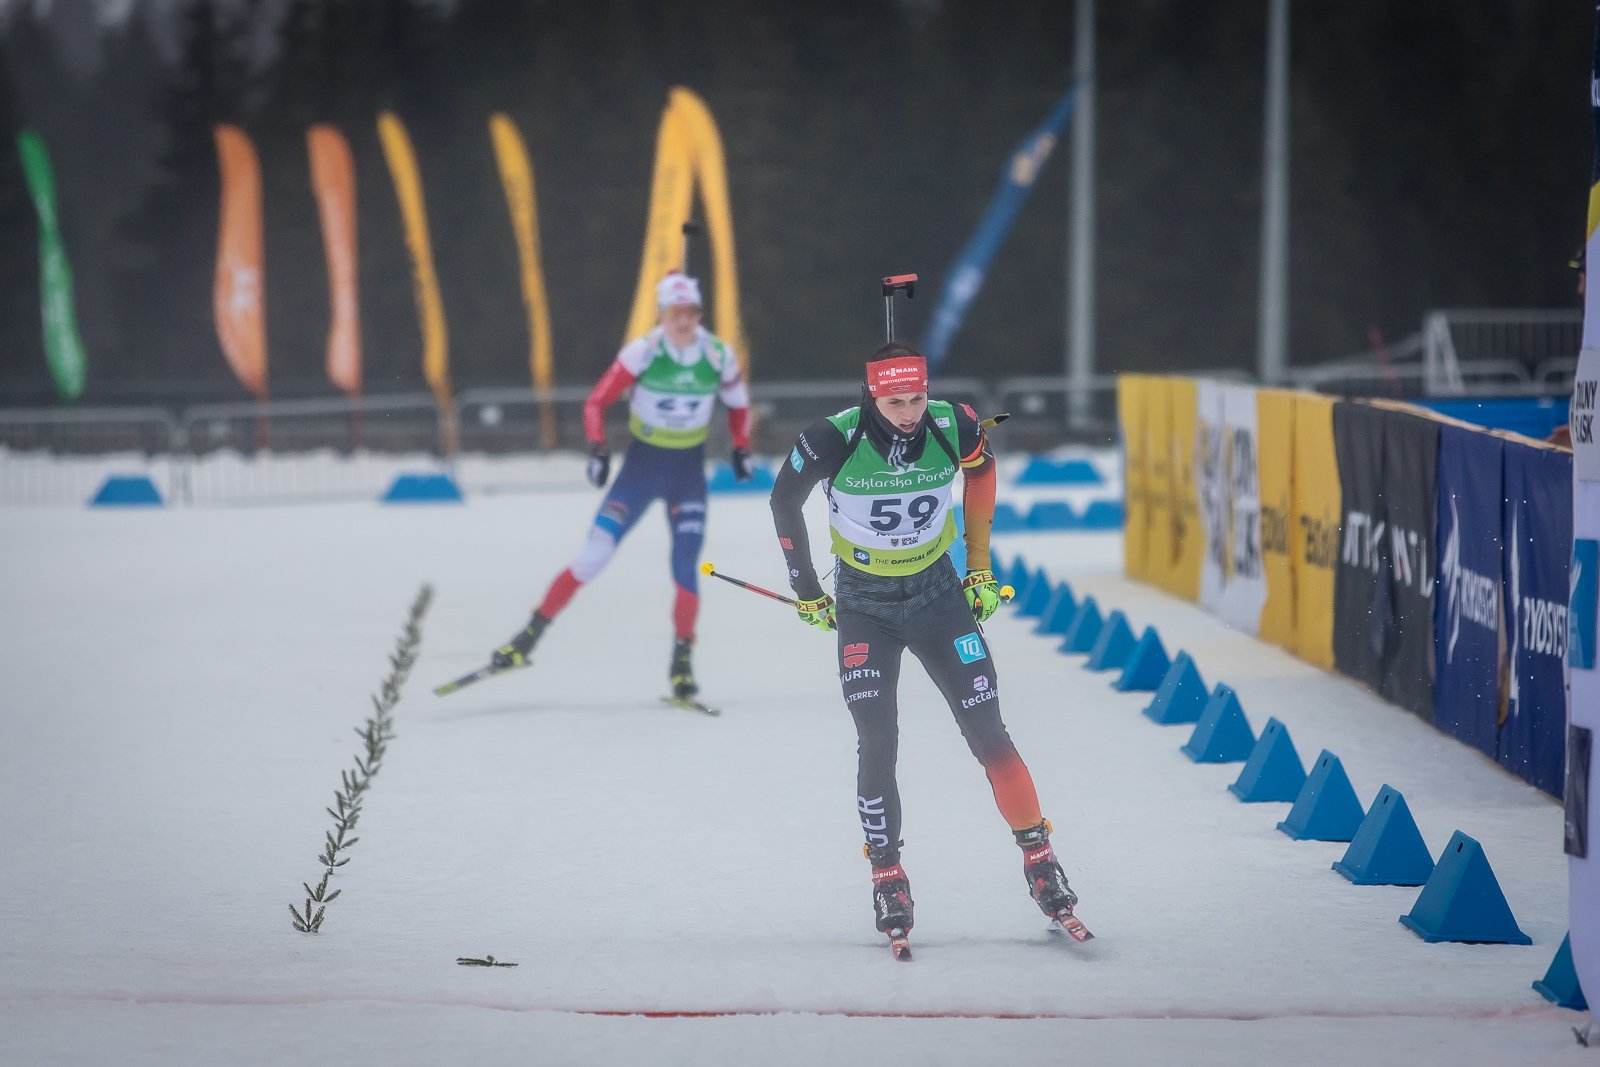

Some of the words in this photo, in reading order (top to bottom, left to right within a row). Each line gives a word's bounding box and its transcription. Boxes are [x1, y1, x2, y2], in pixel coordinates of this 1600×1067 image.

[845, 476, 912, 490] Szklarska
[869, 494, 939, 532] 59
[890, 552, 926, 565] OFFICIAL
[959, 637, 983, 657] TQ
[848, 689, 880, 702] TERREX
[857, 795, 890, 848] GER
